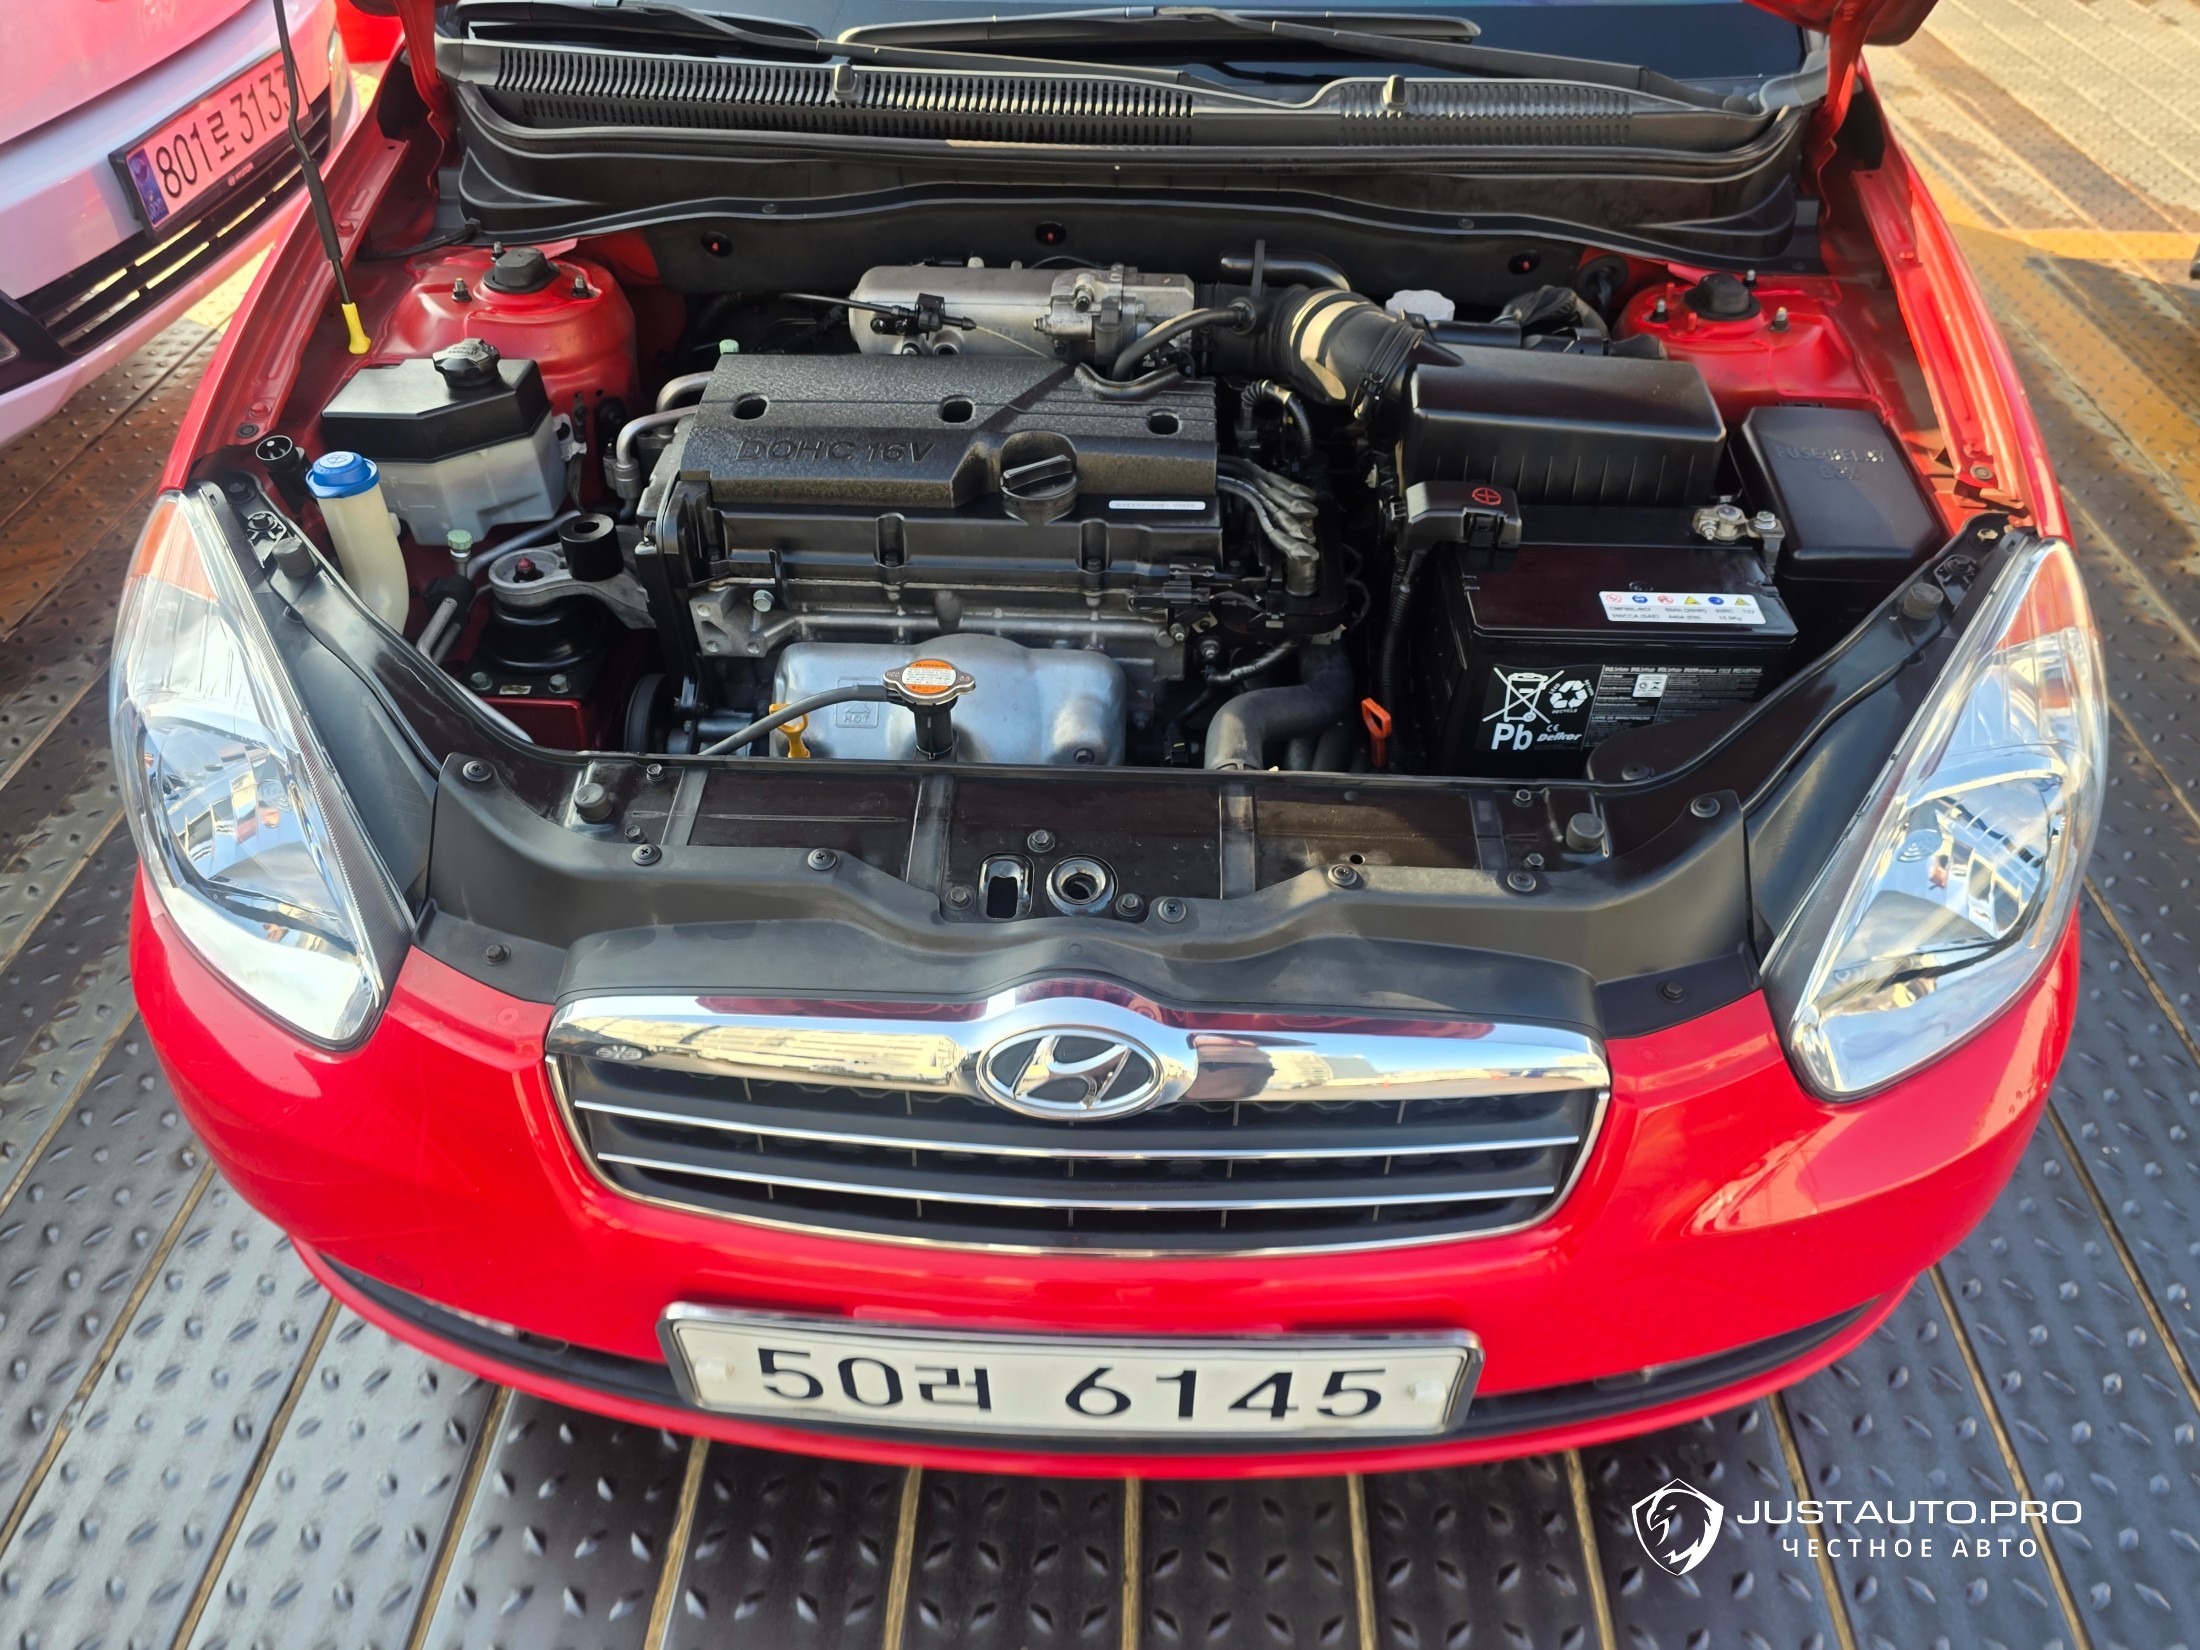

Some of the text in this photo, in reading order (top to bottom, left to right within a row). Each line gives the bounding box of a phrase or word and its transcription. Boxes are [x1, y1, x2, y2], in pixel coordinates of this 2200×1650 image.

[155, 110, 235, 199] 801로
[736, 439, 935, 464] DOHC 16V
[1491, 722, 1534, 751] Pb
[1536, 731, 1583, 742] Delkor
[757, 1348, 1387, 1421] 50러 6145
